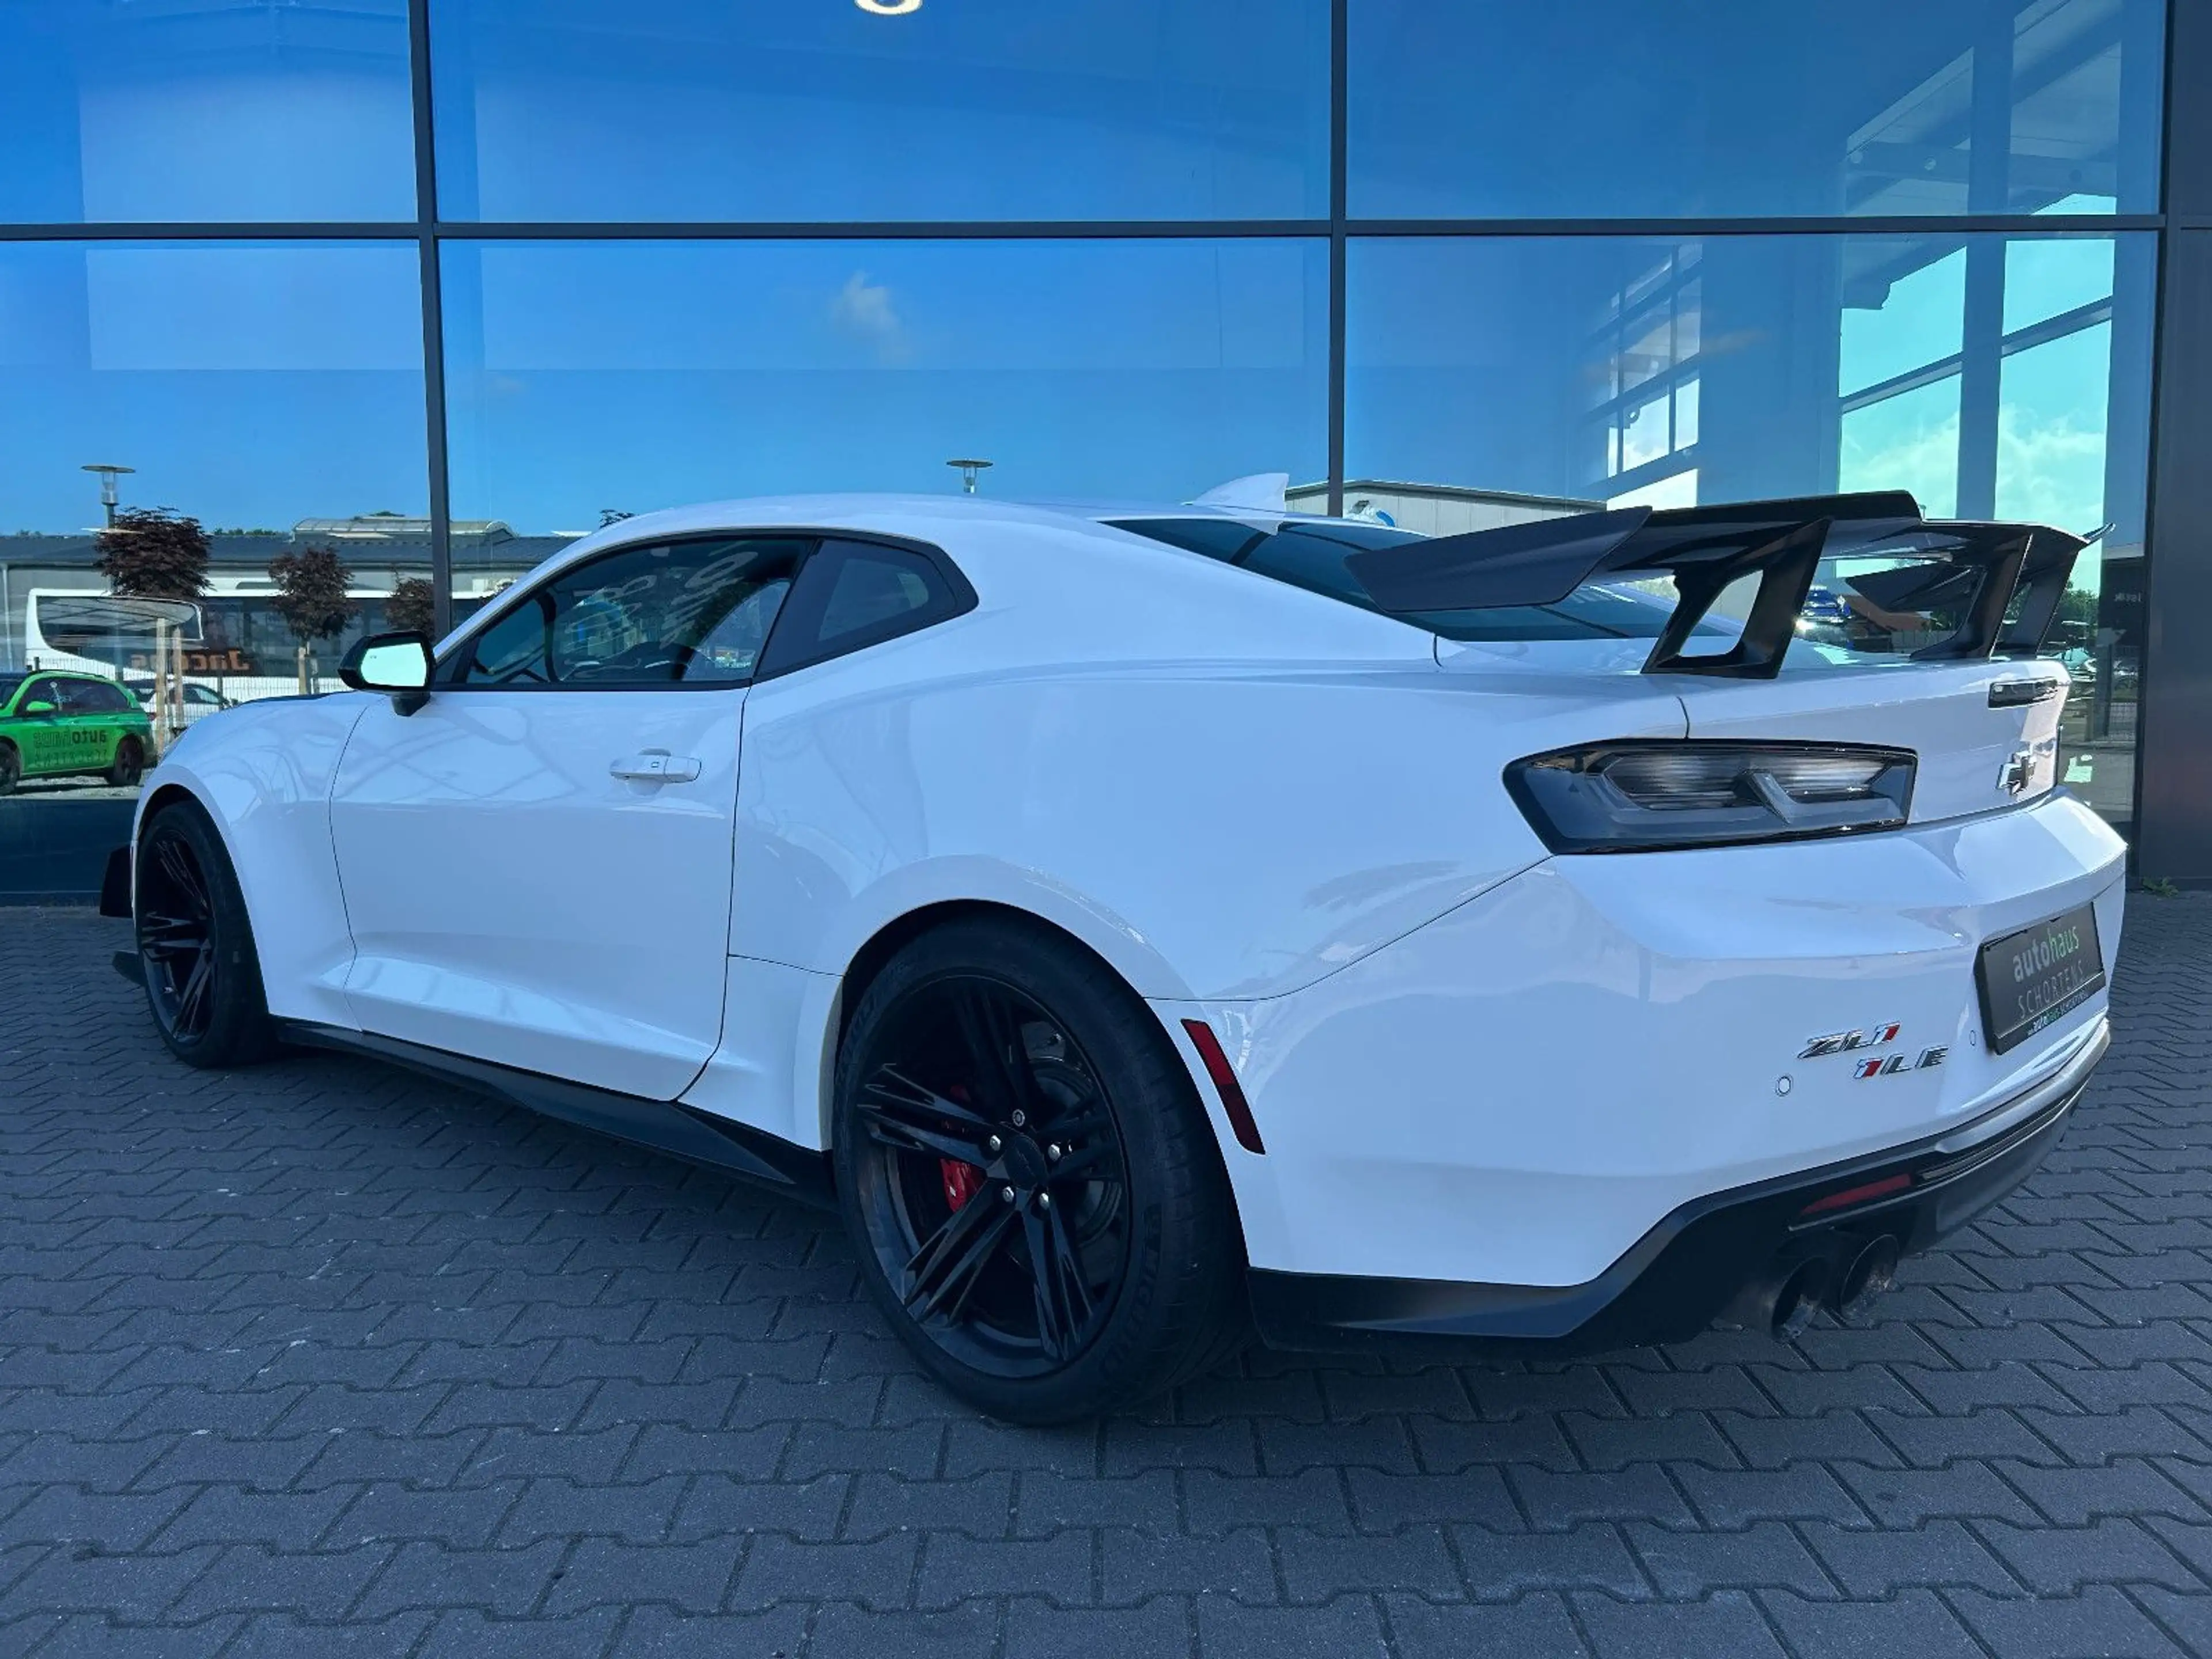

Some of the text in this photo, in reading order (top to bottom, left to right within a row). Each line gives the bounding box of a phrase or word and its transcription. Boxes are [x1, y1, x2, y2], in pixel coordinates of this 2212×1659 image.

[2013, 926, 2079, 982] autohaus
[2017, 959, 2084, 1019] SCHORTENS
[1797, 1021, 1901, 1059] ZL1
[1853, 1045, 1949, 1078] 1LE
